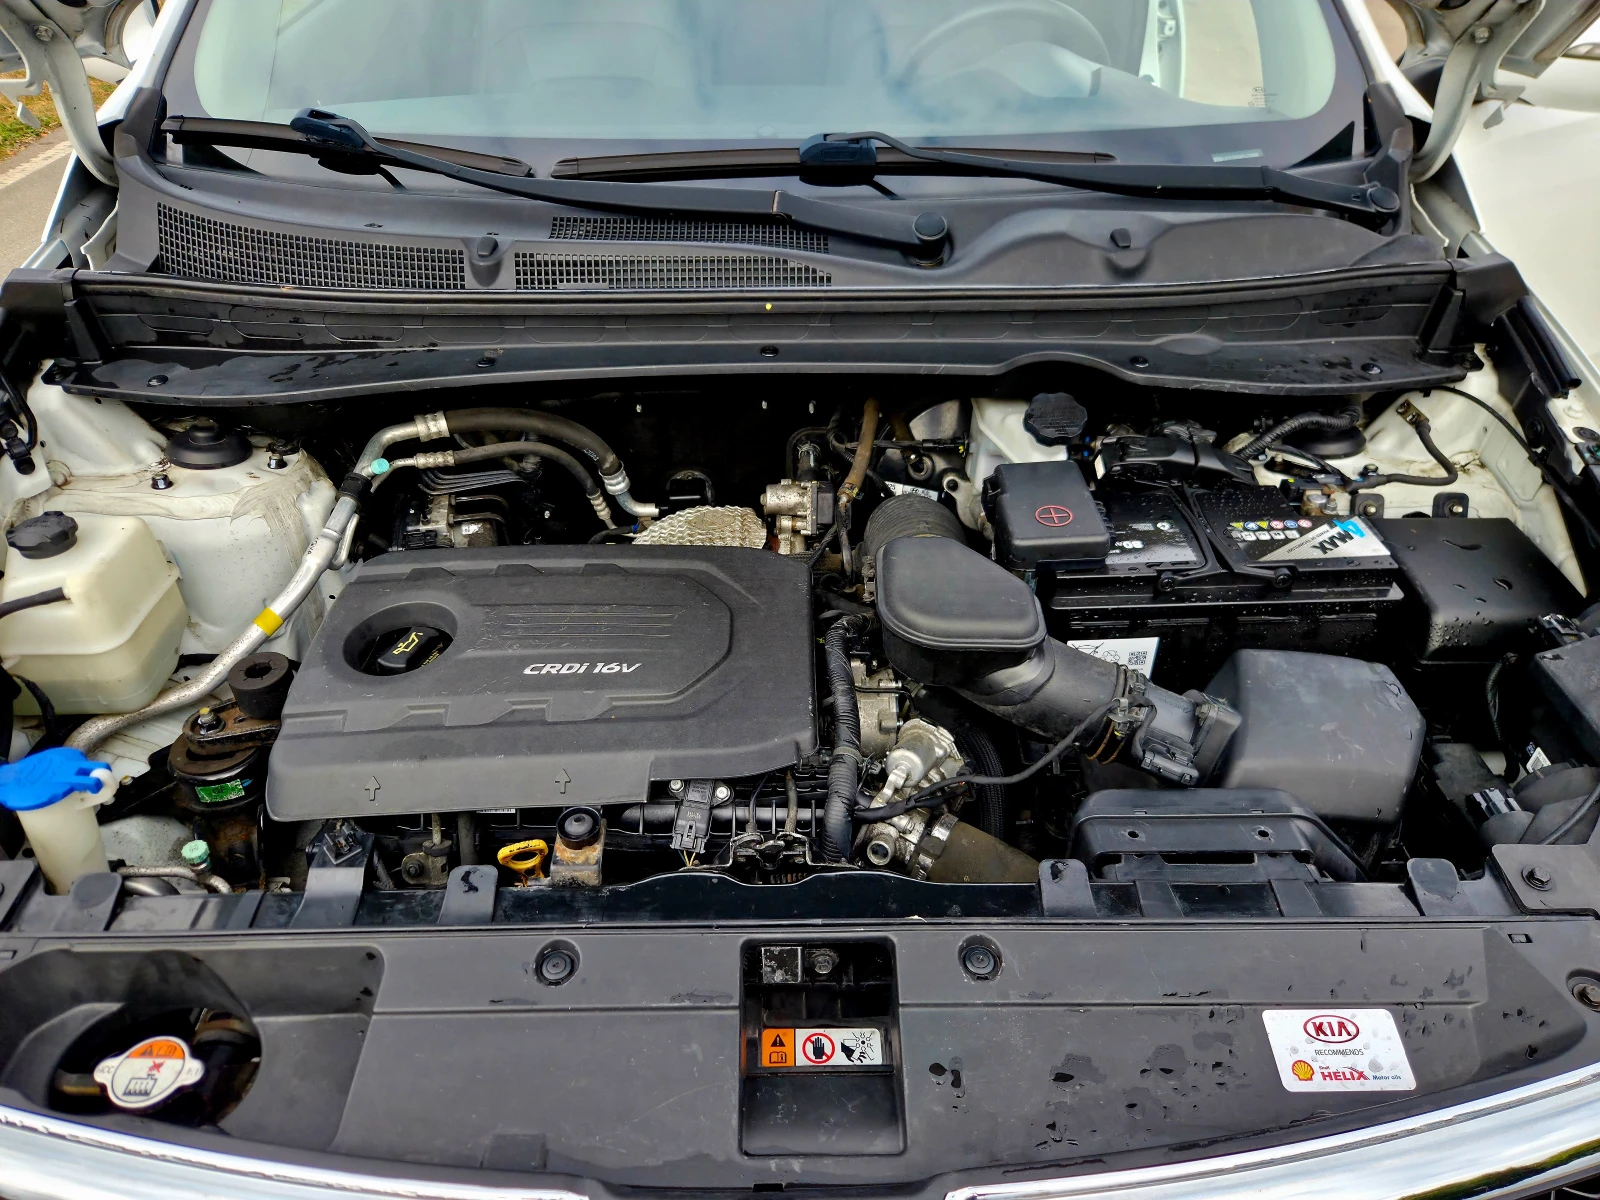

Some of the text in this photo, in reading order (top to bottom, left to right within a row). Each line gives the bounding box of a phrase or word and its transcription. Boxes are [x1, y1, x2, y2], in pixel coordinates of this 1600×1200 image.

[522, 662, 643, 675] CRDi 16V
[1311, 1021, 1353, 1037] KIA
[1314, 1048, 1365, 1056] RECOMMENDS
[1320, 1070, 1370, 1081] HELIX
